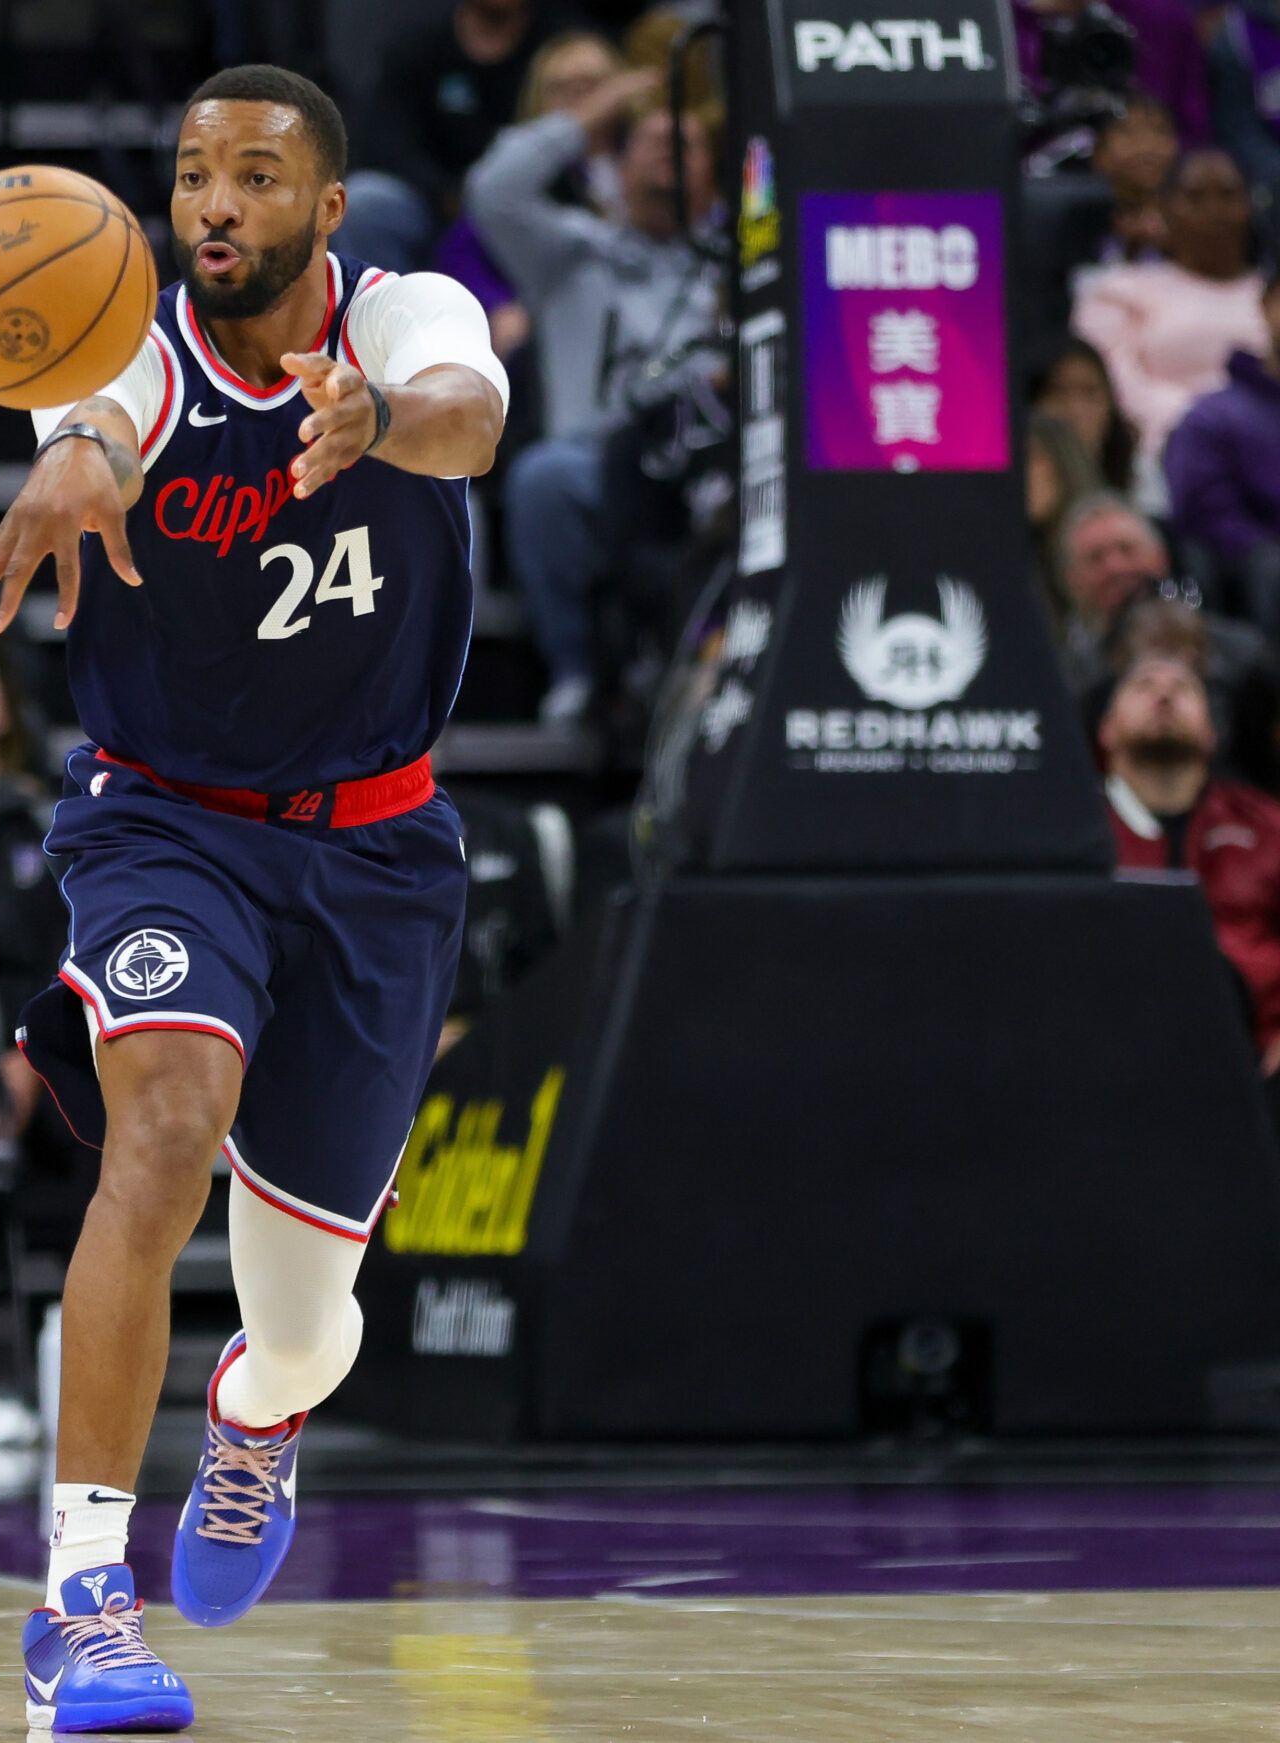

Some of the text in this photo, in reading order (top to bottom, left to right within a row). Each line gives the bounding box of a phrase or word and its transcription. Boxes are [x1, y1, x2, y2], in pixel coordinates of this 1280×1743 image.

[794, 18, 983, 73] PATH
[155, 454, 338, 558] Clipp
[257, 526, 384, 640] 24
[785, 709, 1041, 751] REDHAWK
[280, 789, 323, 822] LA
